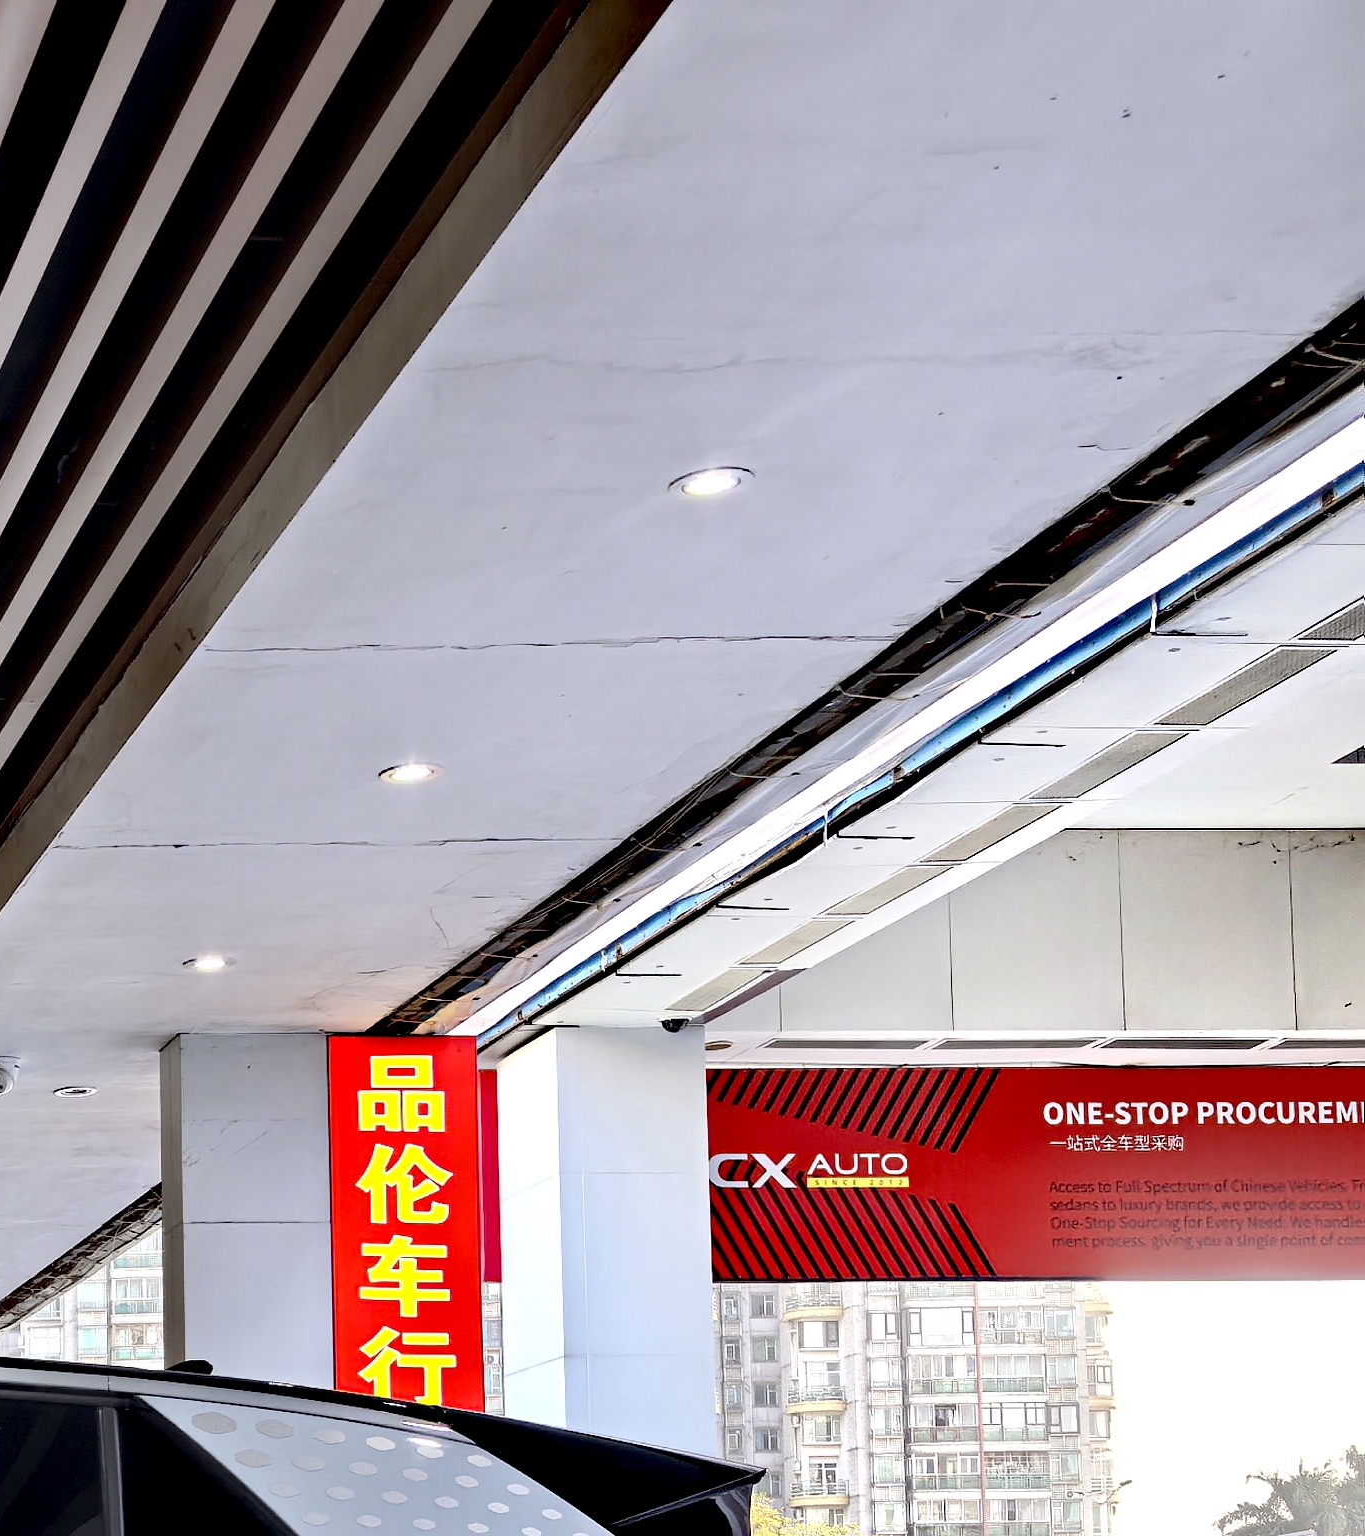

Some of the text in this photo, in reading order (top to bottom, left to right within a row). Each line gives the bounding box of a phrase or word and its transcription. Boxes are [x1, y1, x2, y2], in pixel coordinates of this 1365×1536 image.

[1042, 1101, 1189, 1125] ONE-STOP
[1049, 1134, 1184, 1151] 一站式全车型采购
[709, 1153, 909, 1188] CX AUTO
[1049, 1180, 1095, 1193] Access
[1098, 1181, 1112, 1193] to
[1116, 1180, 1142, 1193] Full
[1144, 1180, 1211, 1196] Spectrum
[1213, 1179, 1228, 1193] of
[1231, 1179, 1284, 1192] Chinese
[1049, 1199, 1098, 1212] sedans
[1102, 1200, 1116, 1211] to
[1120, 1199, 1162, 1214] luxury
[1221, 1202, 1240, 1211] we
[1243, 1199, 1294, 1213] provide
[1299, 1201, 1343, 1211] access
[1347, 1200, 1361, 1211] to
[356, 1054, 457, 1407] 品伦车行
[1050, 1216, 1116, 1231] One-Stop
[1119, 1216, 1180, 1232] Sourcing
[1184, 1215, 1202, 1229] for
[1206, 1215, 1242, 1230] Every
[1289, 1215, 1312, 1228] We
[1052, 1235, 1088, 1249] ment
[1151, 1234, 1192, 1250] giving
[1280, 1234, 1316, 1249] point
